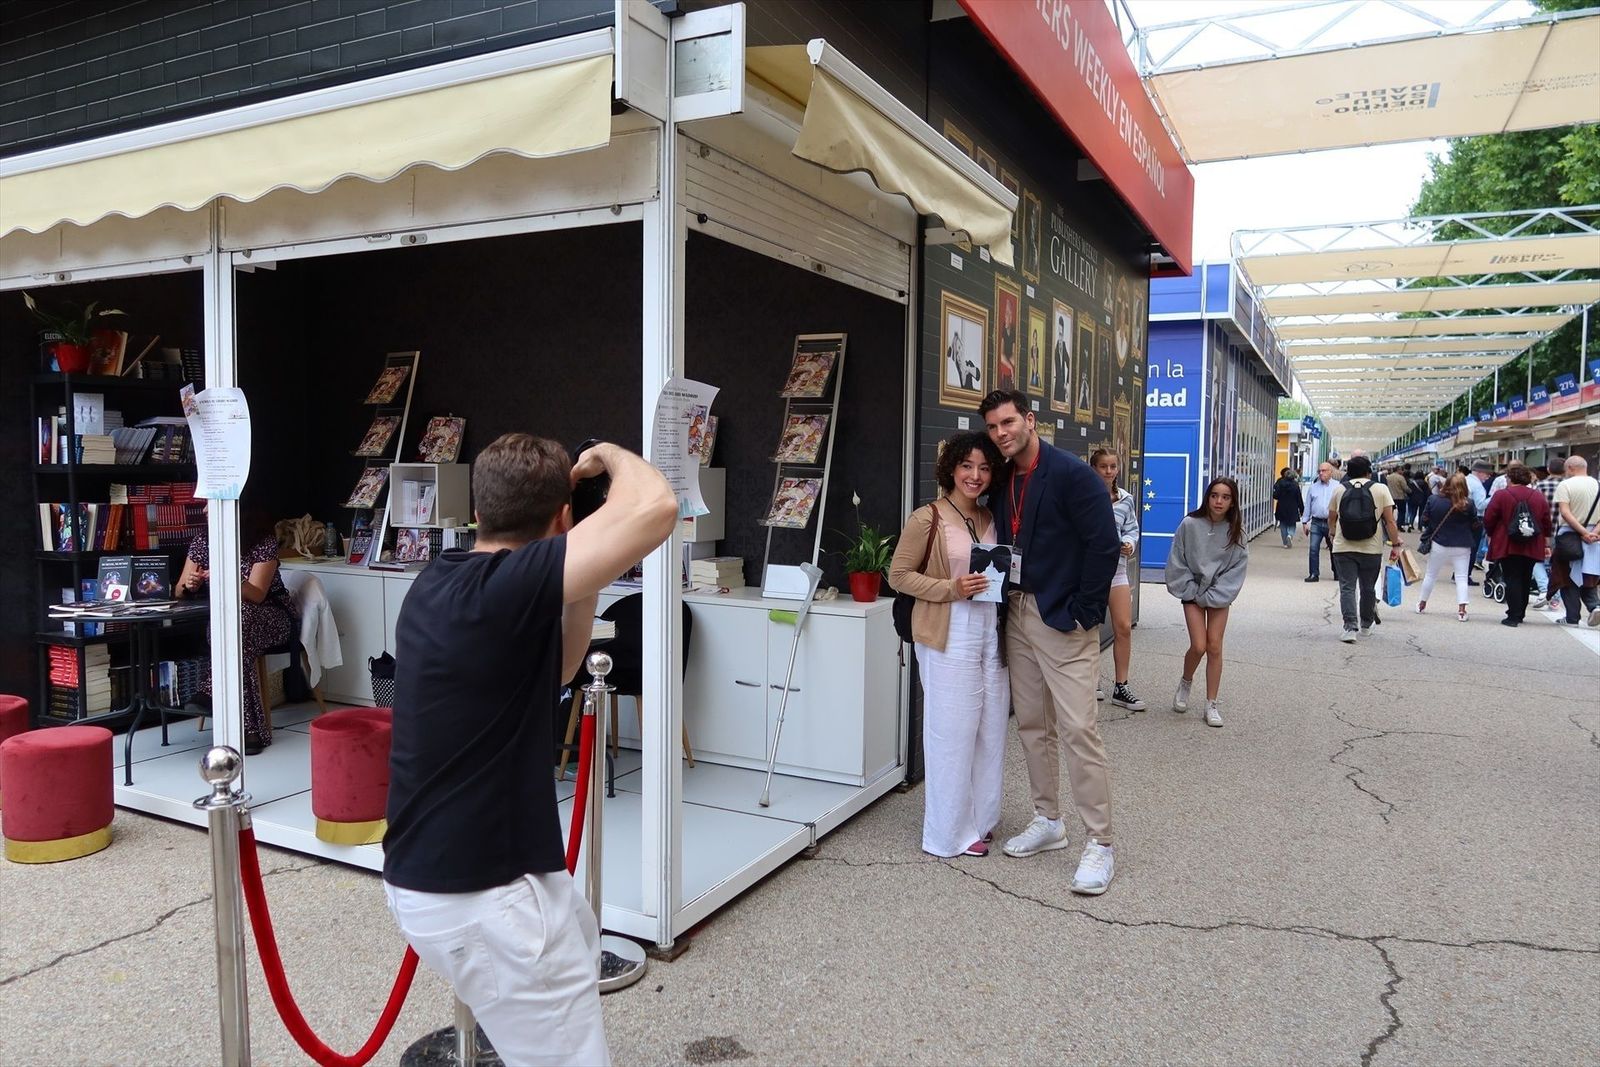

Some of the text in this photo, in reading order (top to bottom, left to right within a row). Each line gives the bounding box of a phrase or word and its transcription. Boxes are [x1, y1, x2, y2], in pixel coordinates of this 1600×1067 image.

[1074, 18, 1120, 126] WEEKLY
[1119, 98, 1133, 149] EN
[1132, 123, 1166, 199] ESPAÑOL
[1334, 98, 1425, 113] DERMO
[1050, 235, 1098, 299] GALLERY
[1166, 358, 1184, 378] la
[1559, 379, 1575, 391] 275
[1512, 399, 1524, 408] 277
